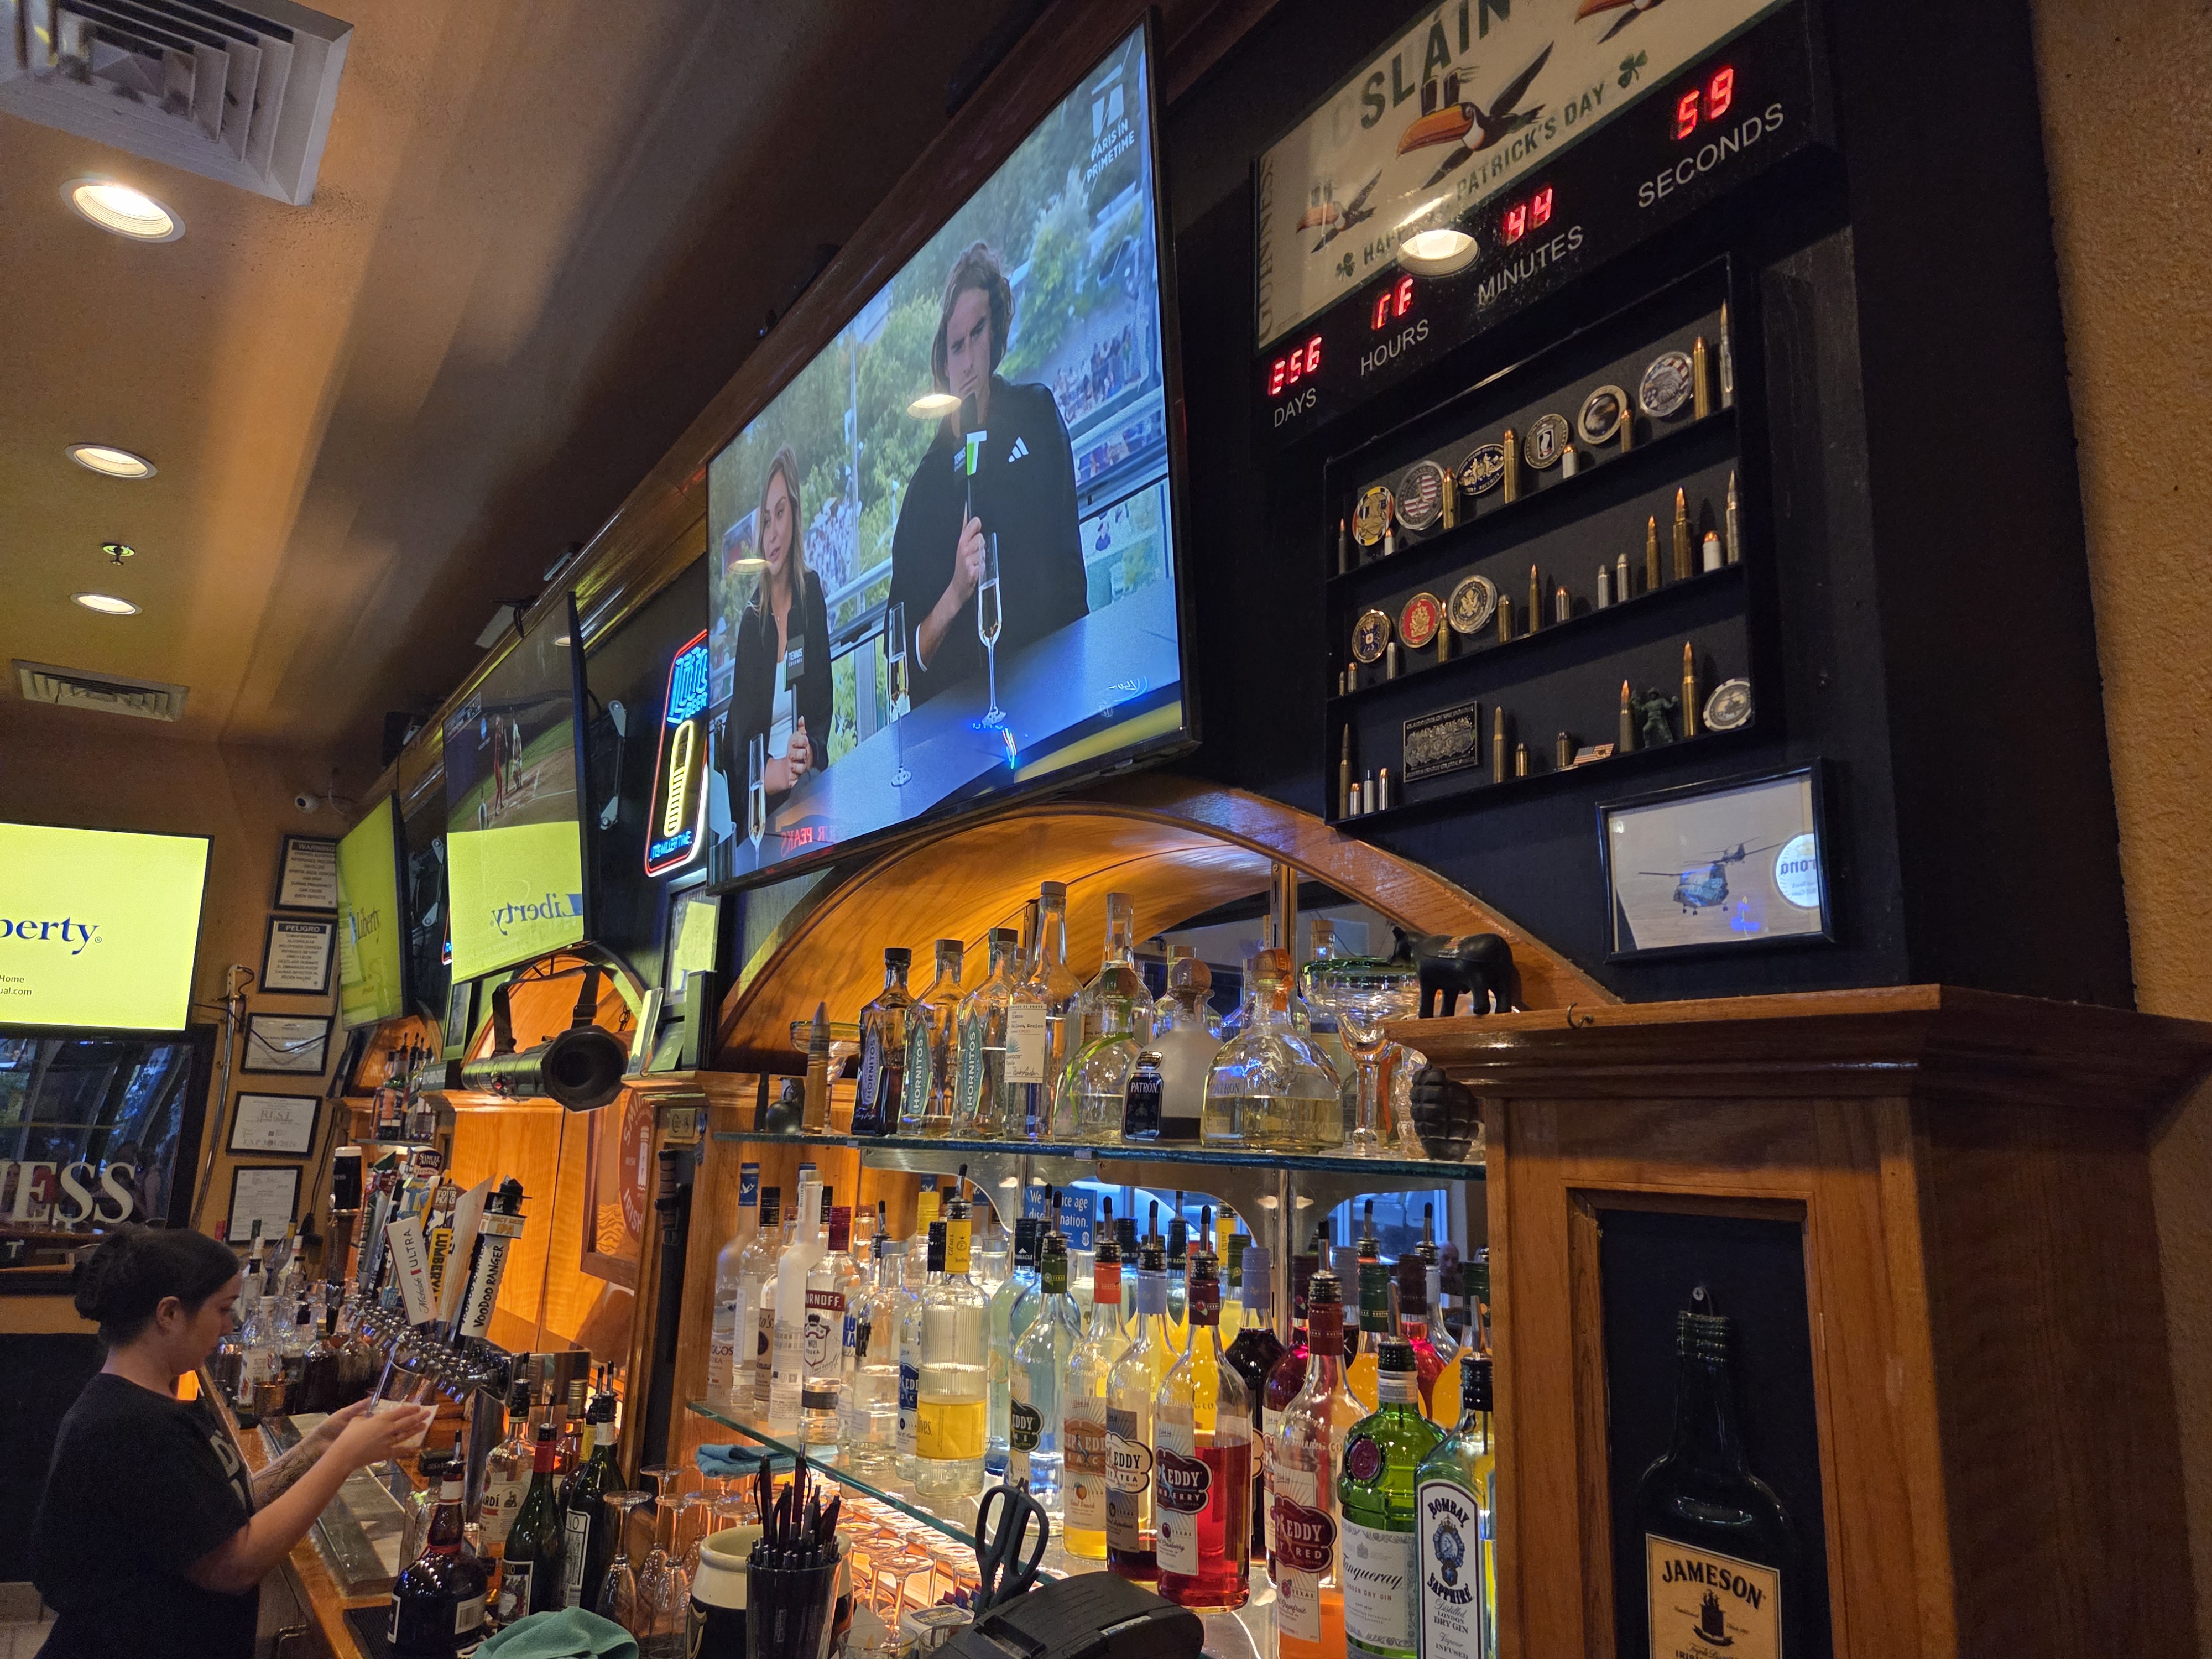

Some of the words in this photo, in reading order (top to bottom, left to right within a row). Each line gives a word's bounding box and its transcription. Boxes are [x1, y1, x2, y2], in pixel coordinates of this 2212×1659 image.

[1091, 128, 1117, 162] PARIS
[1118, 118, 1129, 136] IN
[1455, 114, 1557, 202] PATRICK'S
[1563, 80, 1606, 127] DAY
[1087, 130, 1135, 183] PRIMETIME
[1505, 186, 1553, 244] 44
[1676, 67, 1734, 140] 59
[1273, 387, 1317, 429] DAYS
[1360, 318, 1430, 377] HOURS
[1478, 225, 1584, 307] MINUTES
[1637, 102, 1785, 208] SECONDS
[685, 691, 708, 718] BEER
[299, 843, 335, 853] WARNING
[866, 1039, 877, 1099] HORNITOS
[912, 1038, 924, 1109] HORNITOS
[967, 1031, 976, 1106] HORNITOS
[1130, 1079, 1157, 1093] PATRÓN
[419, 1152, 441, 1163] SAMUEL
[419, 1158, 439, 1167] ADAMS
[0, 1161, 136, 1224] ESS
[436, 1189, 457, 1198] FOUR
[1030, 1189, 1042, 1204] We
[1074, 1197, 1089, 1212] age
[495, 1222, 515, 1236] IPA
[403, 1227, 419, 1269] ULTRA
[414, 1277, 429, 1314] Michelob
[473, 1287, 494, 1328] VOODOO
[486, 1245, 504, 1286] RANGER
[712, 1344, 734, 1356] GOOS
[1012, 1414, 1034, 1430] EDDY
[1114, 1451, 1141, 1470] EDDY
[1120, 1473, 1139, 1483] TEA
[1168, 1468, 1200, 1488] EDDY
[1427, 1498, 1470, 1529] BOMBAY
[1286, 1520, 1322, 1542] EDDY
[1296, 1548, 1322, 1560] RED
[1342, 1552, 1404, 1590] Tanqueray
[1292, 1588, 1314, 1599] TEXAS
[1364, 1589, 1376, 1599] DRY
[1380, 1593, 1392, 1601] GIN
[1427, 1572, 1474, 1605] SAPPHIRE
[1662, 1559, 1764, 1610] JAMESON
[1434, 1598, 1468, 1619] Distilled
[1437, 1611, 1465, 1625] LONDON
[1433, 1615, 1452, 1629] DRY
[1452, 1623, 1469, 1635] GIN
[1439, 1631, 1464, 1648] Vapour
[1436, 1642, 1469, 1659] INFUSED
